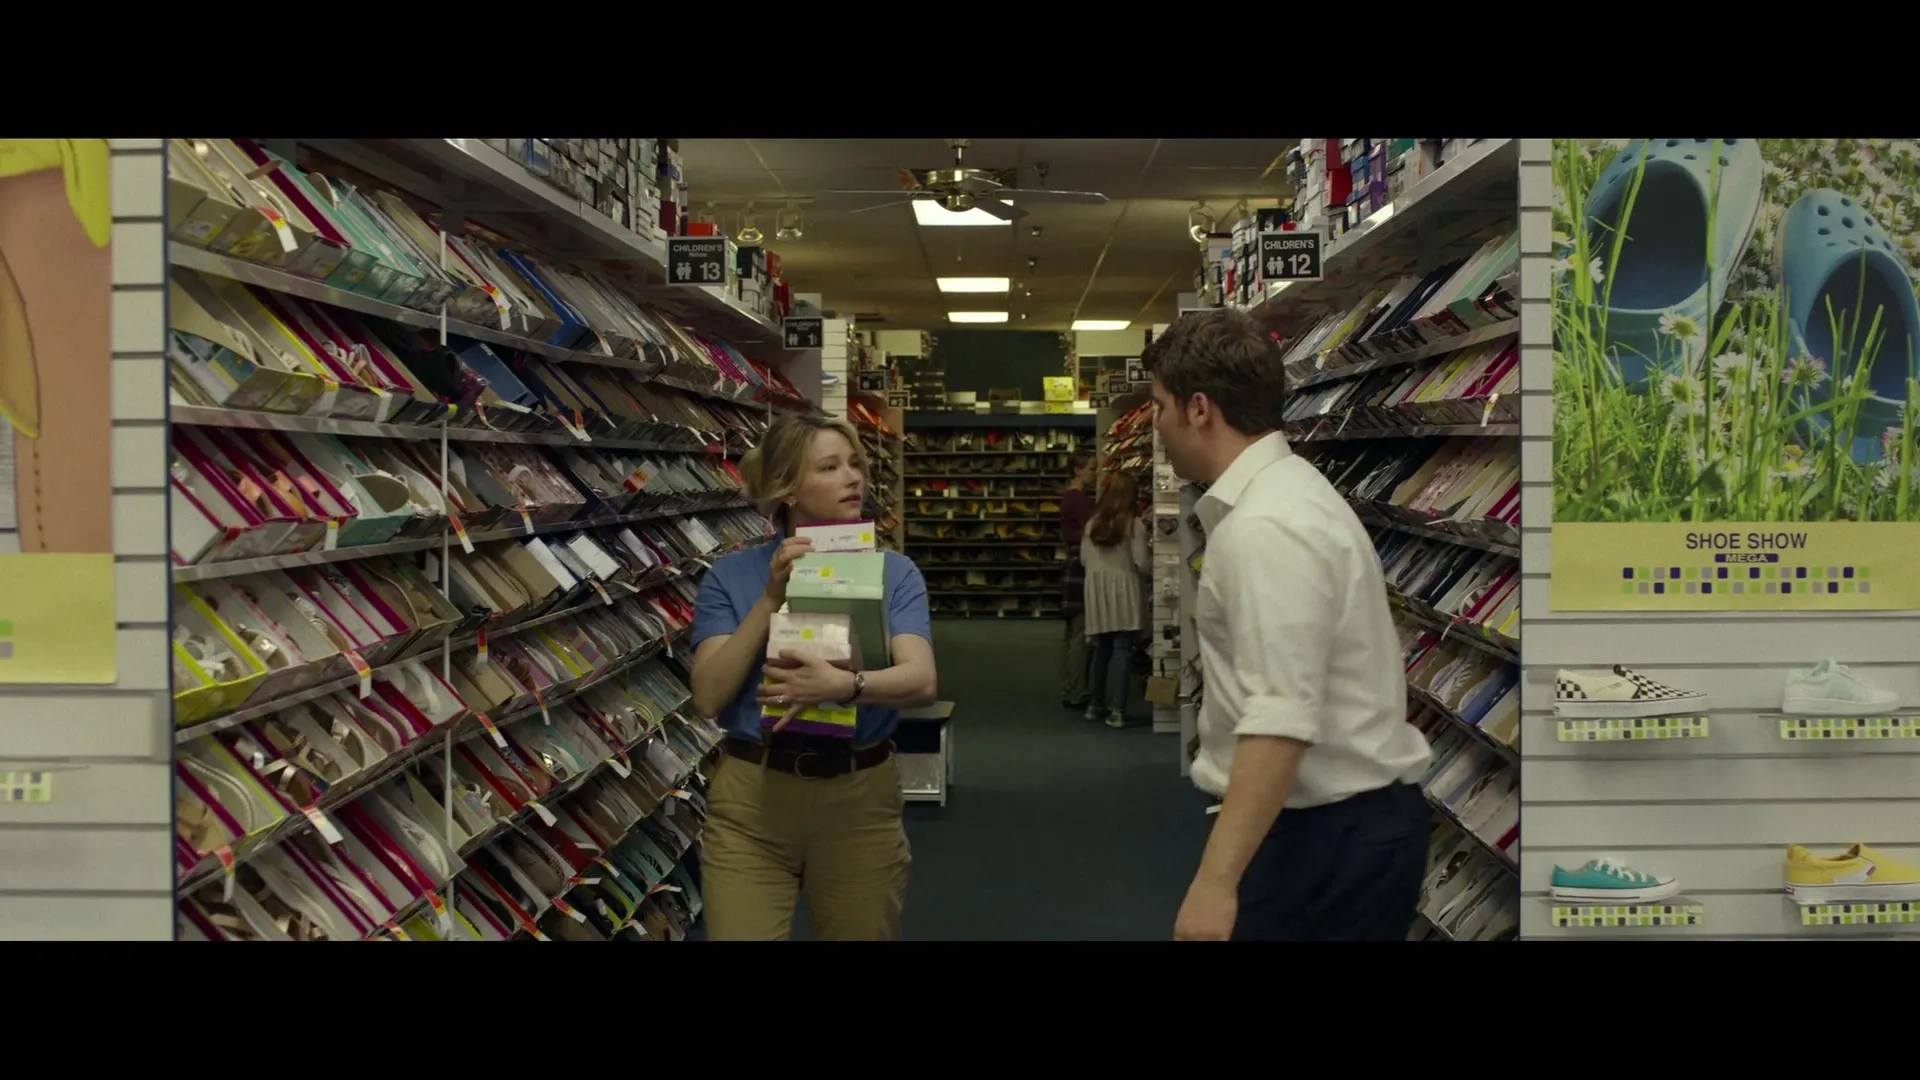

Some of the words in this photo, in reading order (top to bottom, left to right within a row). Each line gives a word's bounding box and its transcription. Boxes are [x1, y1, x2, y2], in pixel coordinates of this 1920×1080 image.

[673, 244, 723, 252] CHILDREN'S
[1264, 240, 1315, 250] CHILDREN'S
[699, 262, 721, 280] 13
[1288, 254, 1312, 275] 12
[1686, 532, 1741, 549] SHOE
[1747, 532, 1807, 549] SHOW
[1725, 554, 1768, 563] MEGA
